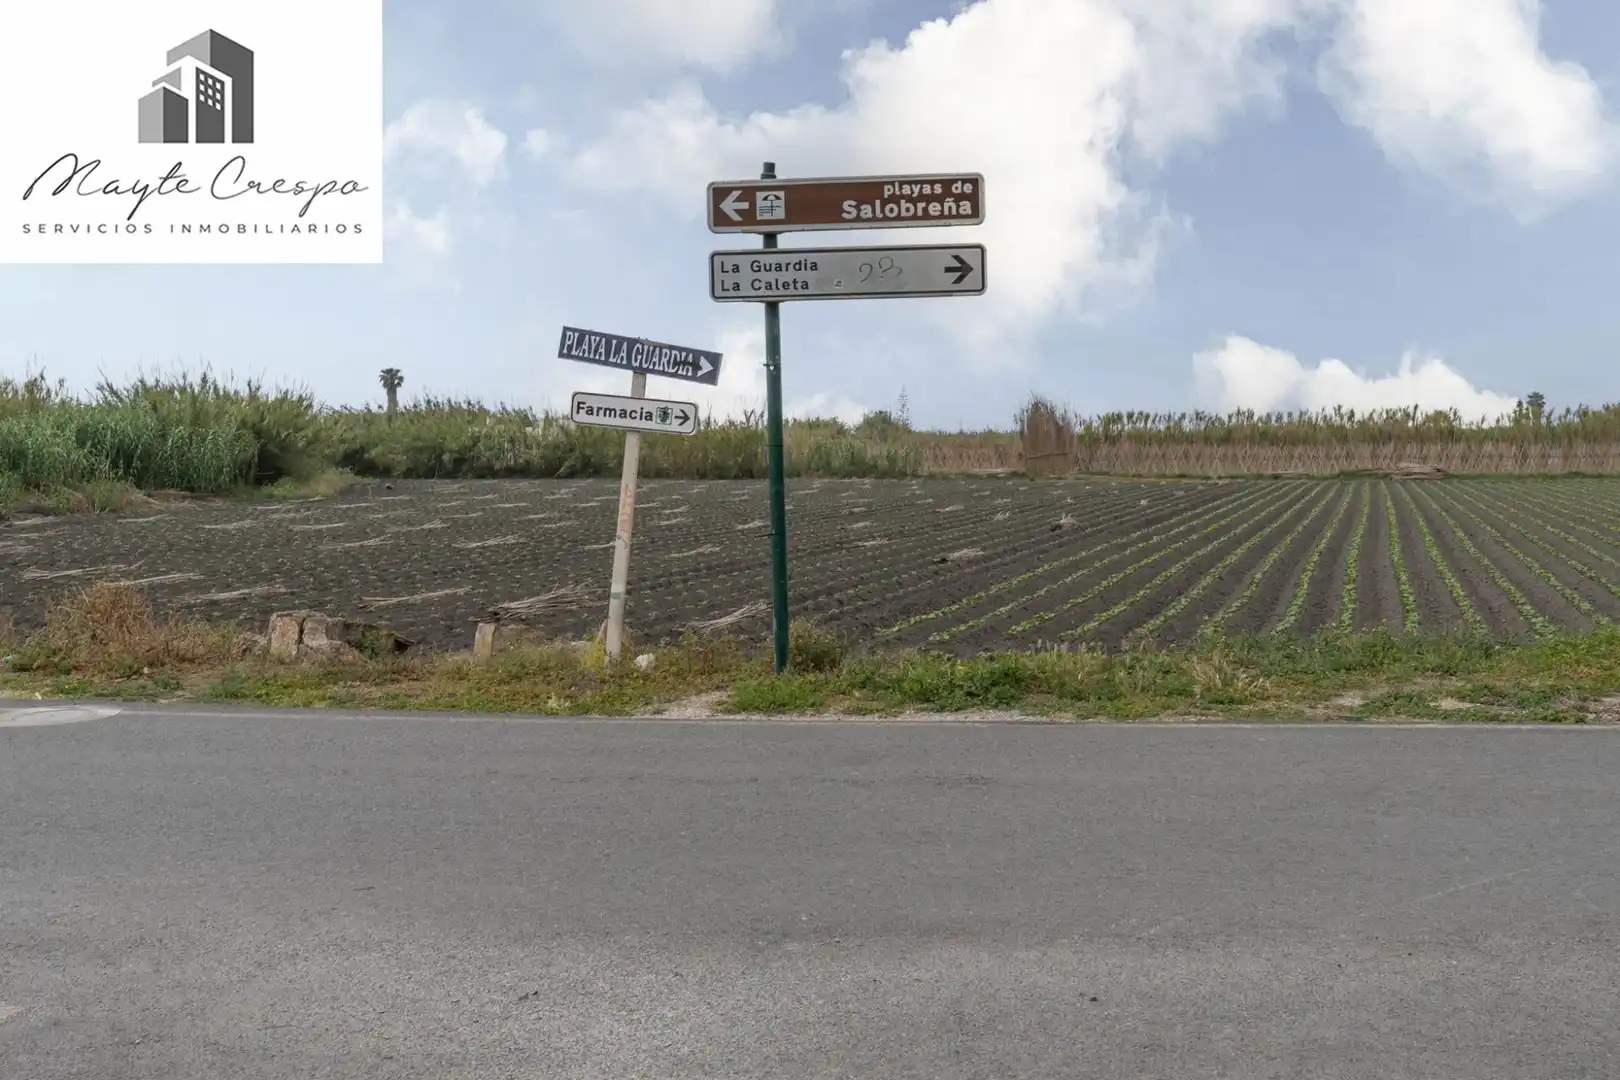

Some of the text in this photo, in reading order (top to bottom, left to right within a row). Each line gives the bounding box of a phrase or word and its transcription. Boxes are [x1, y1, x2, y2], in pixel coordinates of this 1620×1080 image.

[883, 180, 974, 198] playas de
[841, 196, 972, 220] Salobreña
[720, 258, 819, 274] La Guardia
[721, 278, 810, 292] La Caleta
[562, 330, 694, 376] PLAYA LA GUARDIA
[576, 401, 653, 422] Farmacia
